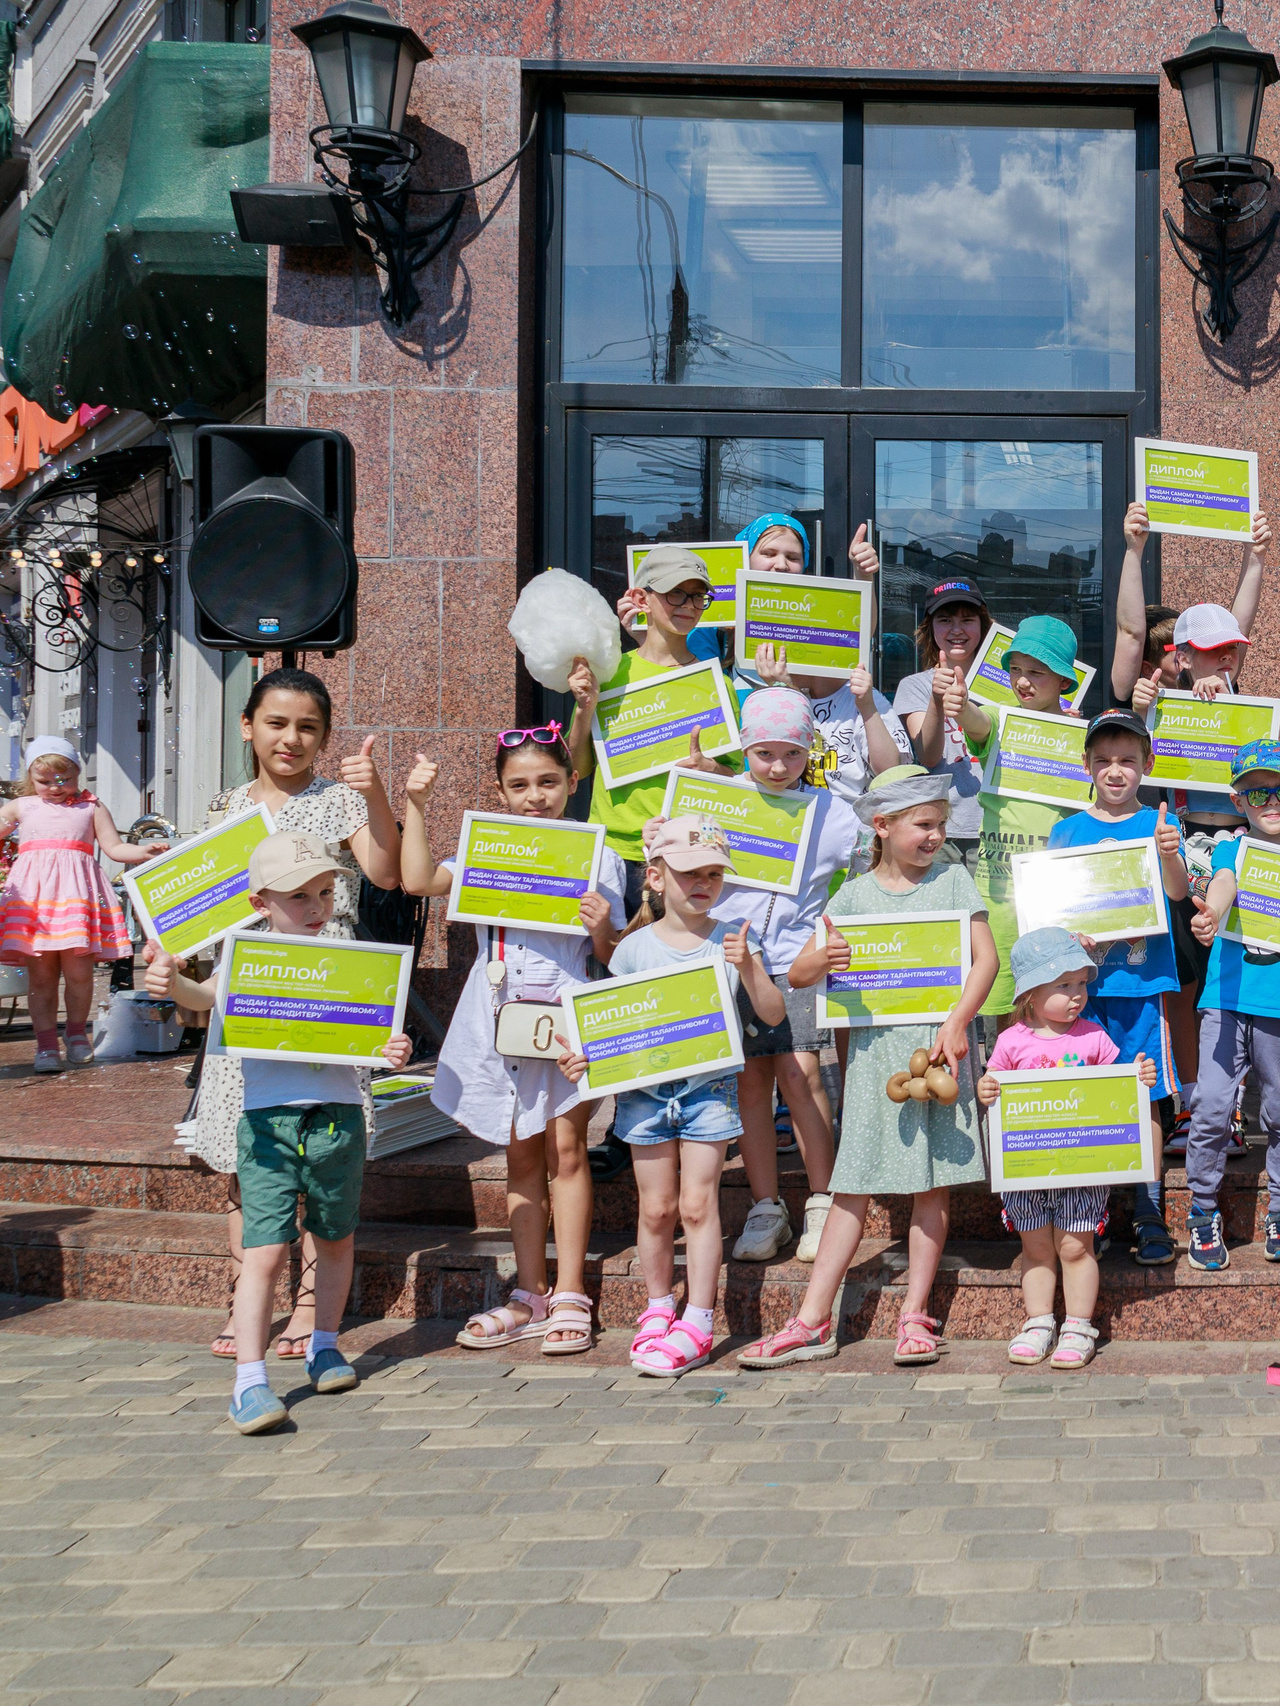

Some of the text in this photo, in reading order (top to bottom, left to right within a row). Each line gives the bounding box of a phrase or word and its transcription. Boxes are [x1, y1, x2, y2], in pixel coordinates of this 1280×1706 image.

[1149, 464, 1205, 478] ДИПЛОМ
[1172, 497, 1205, 505] КОНДИТЕРУ
[1196, 494, 1239, 503] ТАЛАНТЛИВОМУ
[933, 582, 970, 596] PRINCESS
[750, 597, 811, 612] ДИПЛОМ
[774, 633, 810, 641] КОНДИТЕРУ
[800, 629, 848, 639] ТАЛАНТЛИВОМУ
[982, 670, 1001, 681] ЮНОМУ
[984, 666, 1002, 676] ВЫДАН
[605, 700, 666, 728] ДИПЛОМ
[1160, 715, 1222, 729] ДИПЛОМ
[609, 713, 710, 748] ВЫДАН САМОМУ ТАЛАНТЛИВОМУ
[611, 731, 673, 754] ЮНОМУ КОНДИТЕРУ
[1006, 731, 1068, 749] ДИПЛОМ
[1181, 750, 1217, 758] КОНДИТЕРУ
[1001, 760, 1061, 774] ЮНОМУ КОНДИТЕРУ
[1025, 758, 1051, 767] САМОМУ
[1052, 763, 1085, 773] ТАЛАНТЛИ
[678, 795, 749, 817] ДИПЛОМ
[731, 834, 784, 849] ТАЛАНТЛИВОМУ
[473, 841, 539, 857] ДИПЛОМ
[149, 859, 215, 903] ДИПЛОМ
[468, 878, 533, 890] ЮНОМУ КОНДИТЕРУ
[523, 877, 575, 888] ТАЛАНТЛИВОМУ
[159, 871, 250, 924] ВЫДАН САМОМУ ТАЛАНТЛИ
[1241, 894, 1265, 904] ВЫДАН
[161, 891, 227, 930] ЮНОМУ КОНДИТЕРУ
[1239, 900, 1265, 910] ЮНОМУ
[850, 942, 902, 955] ПЛОМ
[238, 963, 329, 981] ДИПЛОМ
[891, 970, 947, 978] ТАЛАНТЛИВОМУ
[233, 1006, 322, 1018] ЮНОМУ КОНДИТЕРУ
[234, 998, 377, 1014] ВЫДАН САМОМУ ТАЛАНТЛИВОМУ
[583, 998, 657, 1028] ДИПЛОМ
[588, 1040, 616, 1052] ВЫДАН
[616, 1033, 649, 1045] САМОМУ
[650, 1018, 710, 1036] ТАЛАНТЛИВОМУ
[590, 1036, 664, 1058] ЮНОМУ КОНДИТЕРУ
[1006, 1098, 1079, 1116] ДИПЛОМ
[1068, 1128, 1125, 1137] ТАЛАНТЛИВОМУ
